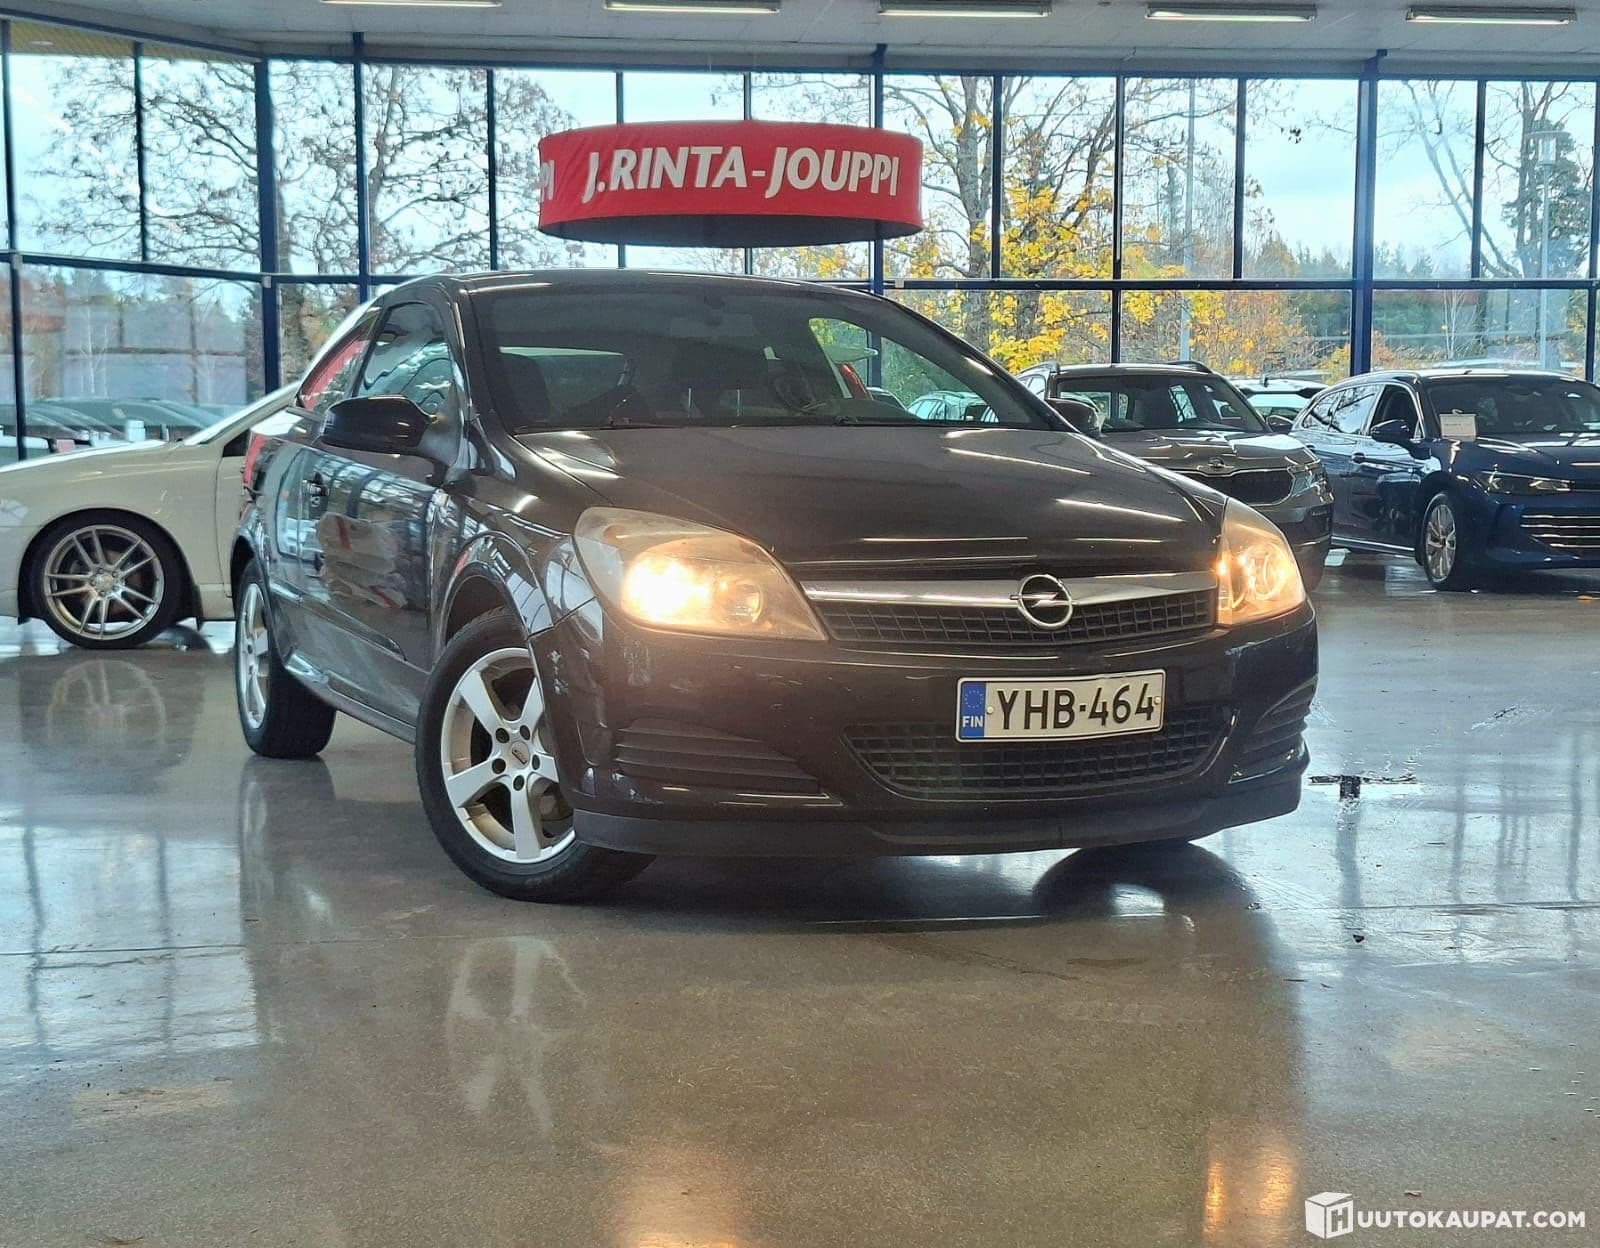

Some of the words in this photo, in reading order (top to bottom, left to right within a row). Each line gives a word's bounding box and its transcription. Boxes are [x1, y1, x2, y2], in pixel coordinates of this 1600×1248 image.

[582, 146, 900, 204] J.RINTA-JOUPPI
[962, 715, 984, 728] FIN
[997, 683, 1154, 730] YHB-464
